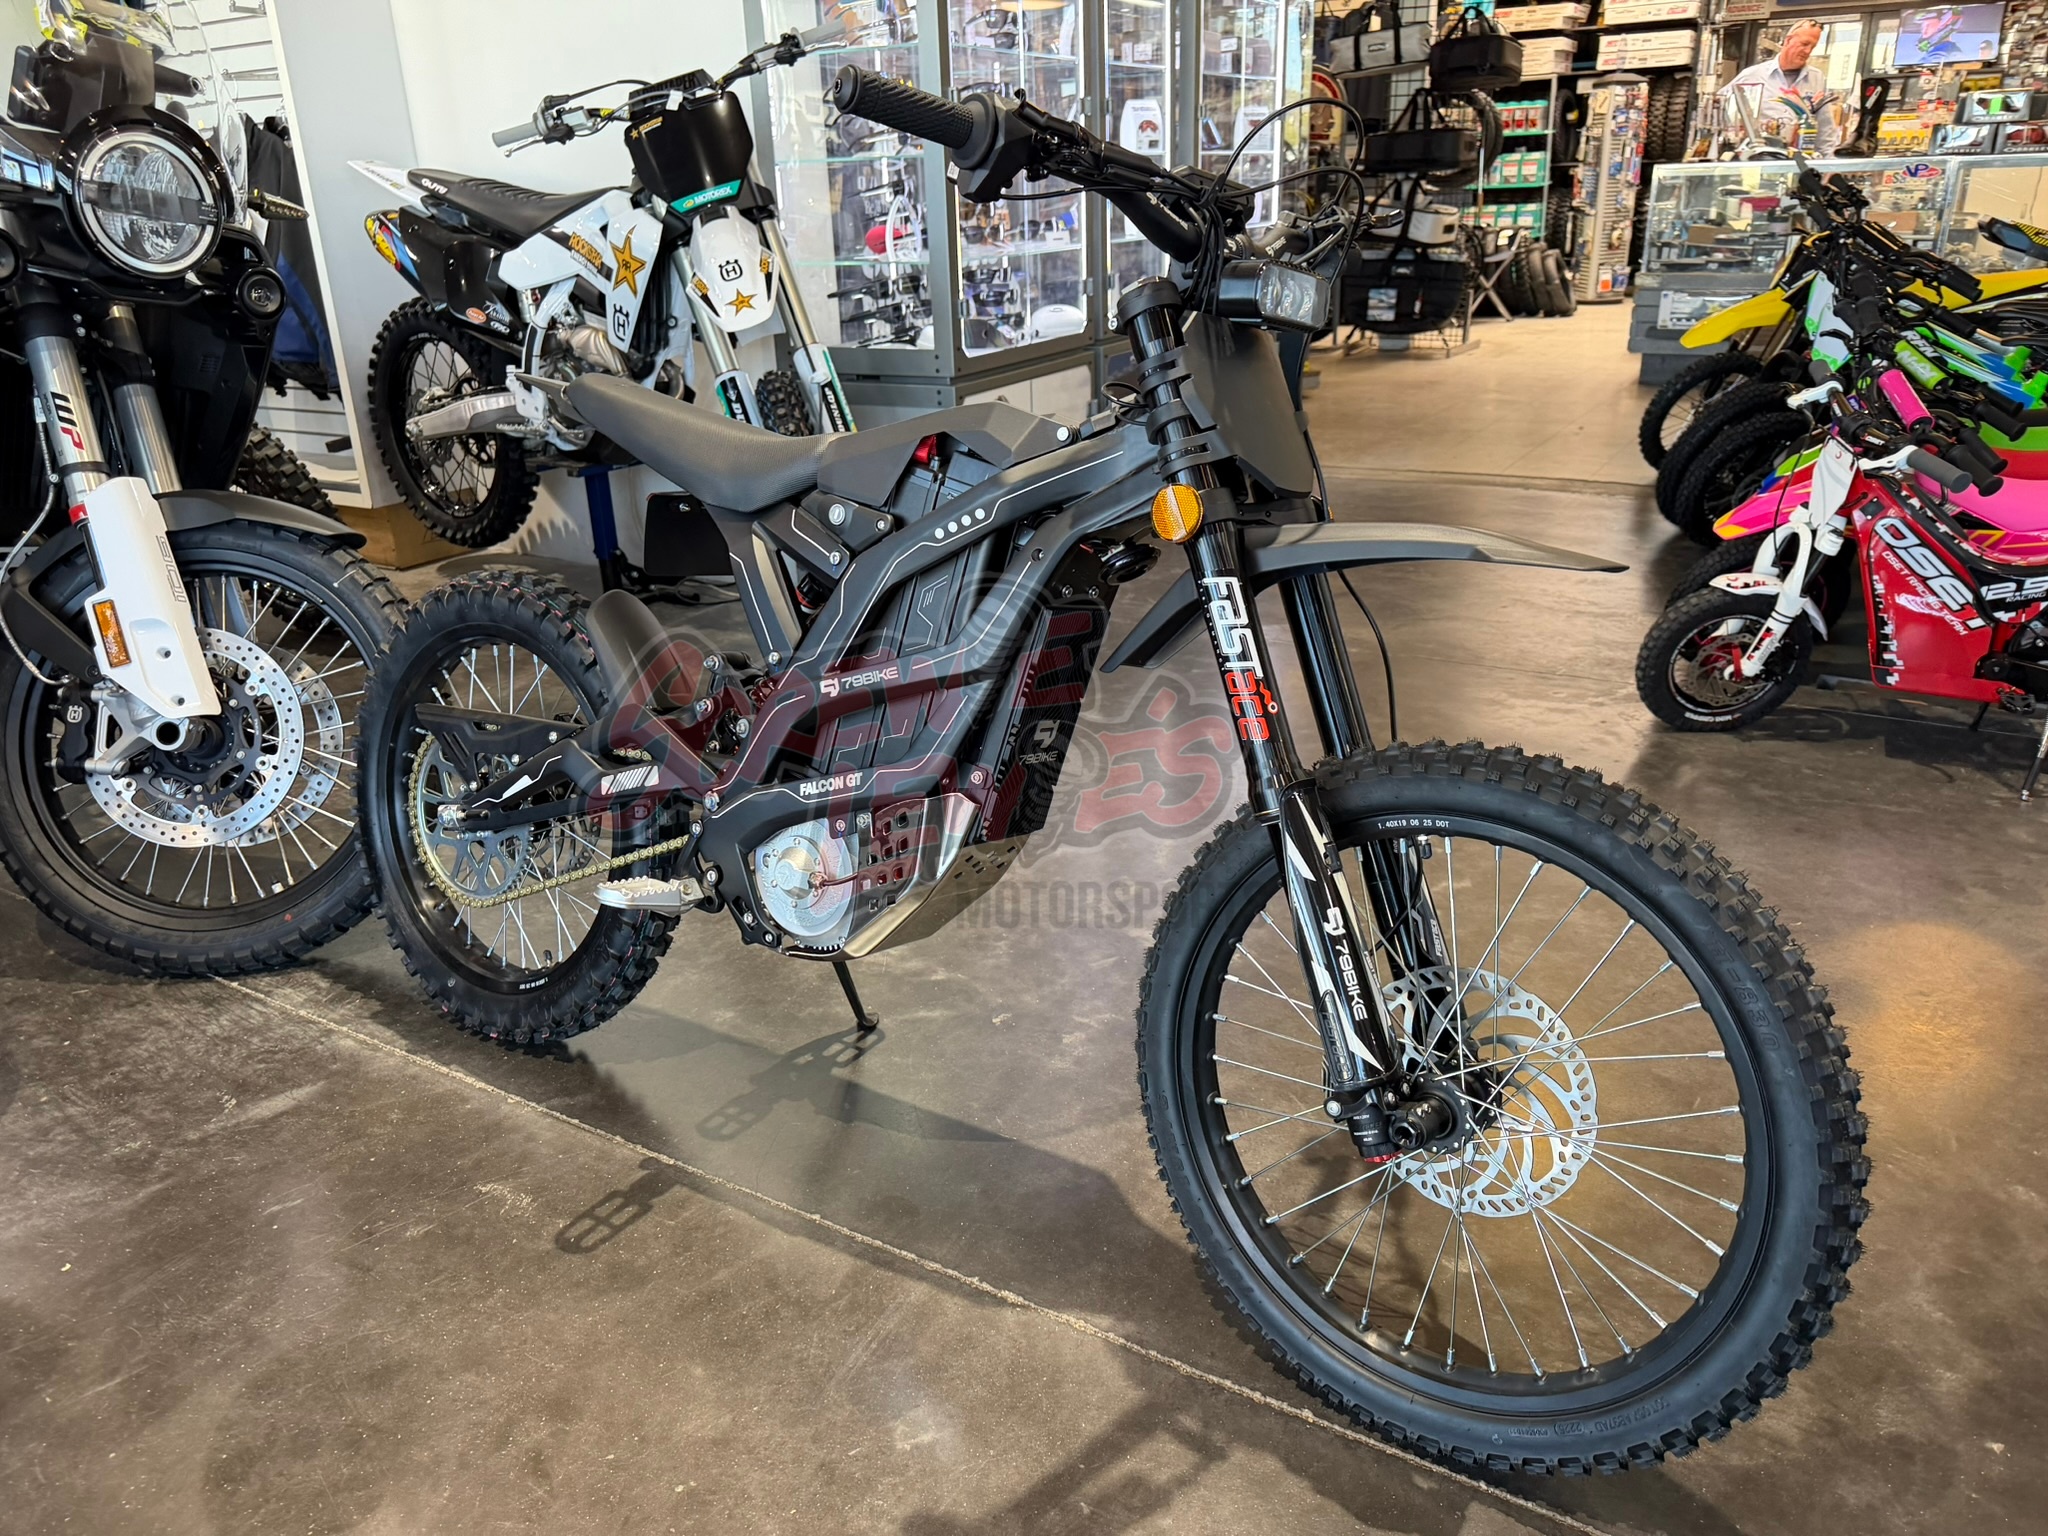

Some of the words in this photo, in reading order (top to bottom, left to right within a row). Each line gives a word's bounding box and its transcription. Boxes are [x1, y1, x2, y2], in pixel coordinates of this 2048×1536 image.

[1906, 164, 1930, 179] VP
[694, 186, 732, 204] MOTOREX
[568, 231, 603, 269] ROCKSTAR
[1900, 330, 1942, 357] RFN
[50, 391, 86, 450] WP
[1882, 551, 1911, 575] OSET
[1906, 576, 1943, 610] RACING
[1942, 608, 1969, 635] TEAM
[2005, 591, 2047, 603] RACING
[841, 666, 899, 689] 79BIKE
[1019, 751, 1059, 766] 79BIKE
[800, 775, 844, 796] FALCON
[845, 772, 863, 787] GT
[1378, 820, 1407, 829] 1.40X19
[1423, 819, 1432, 827] 25
[1435, 820, 1450, 828] DOT
[1335, 939, 1369, 1021] 79BIKE
